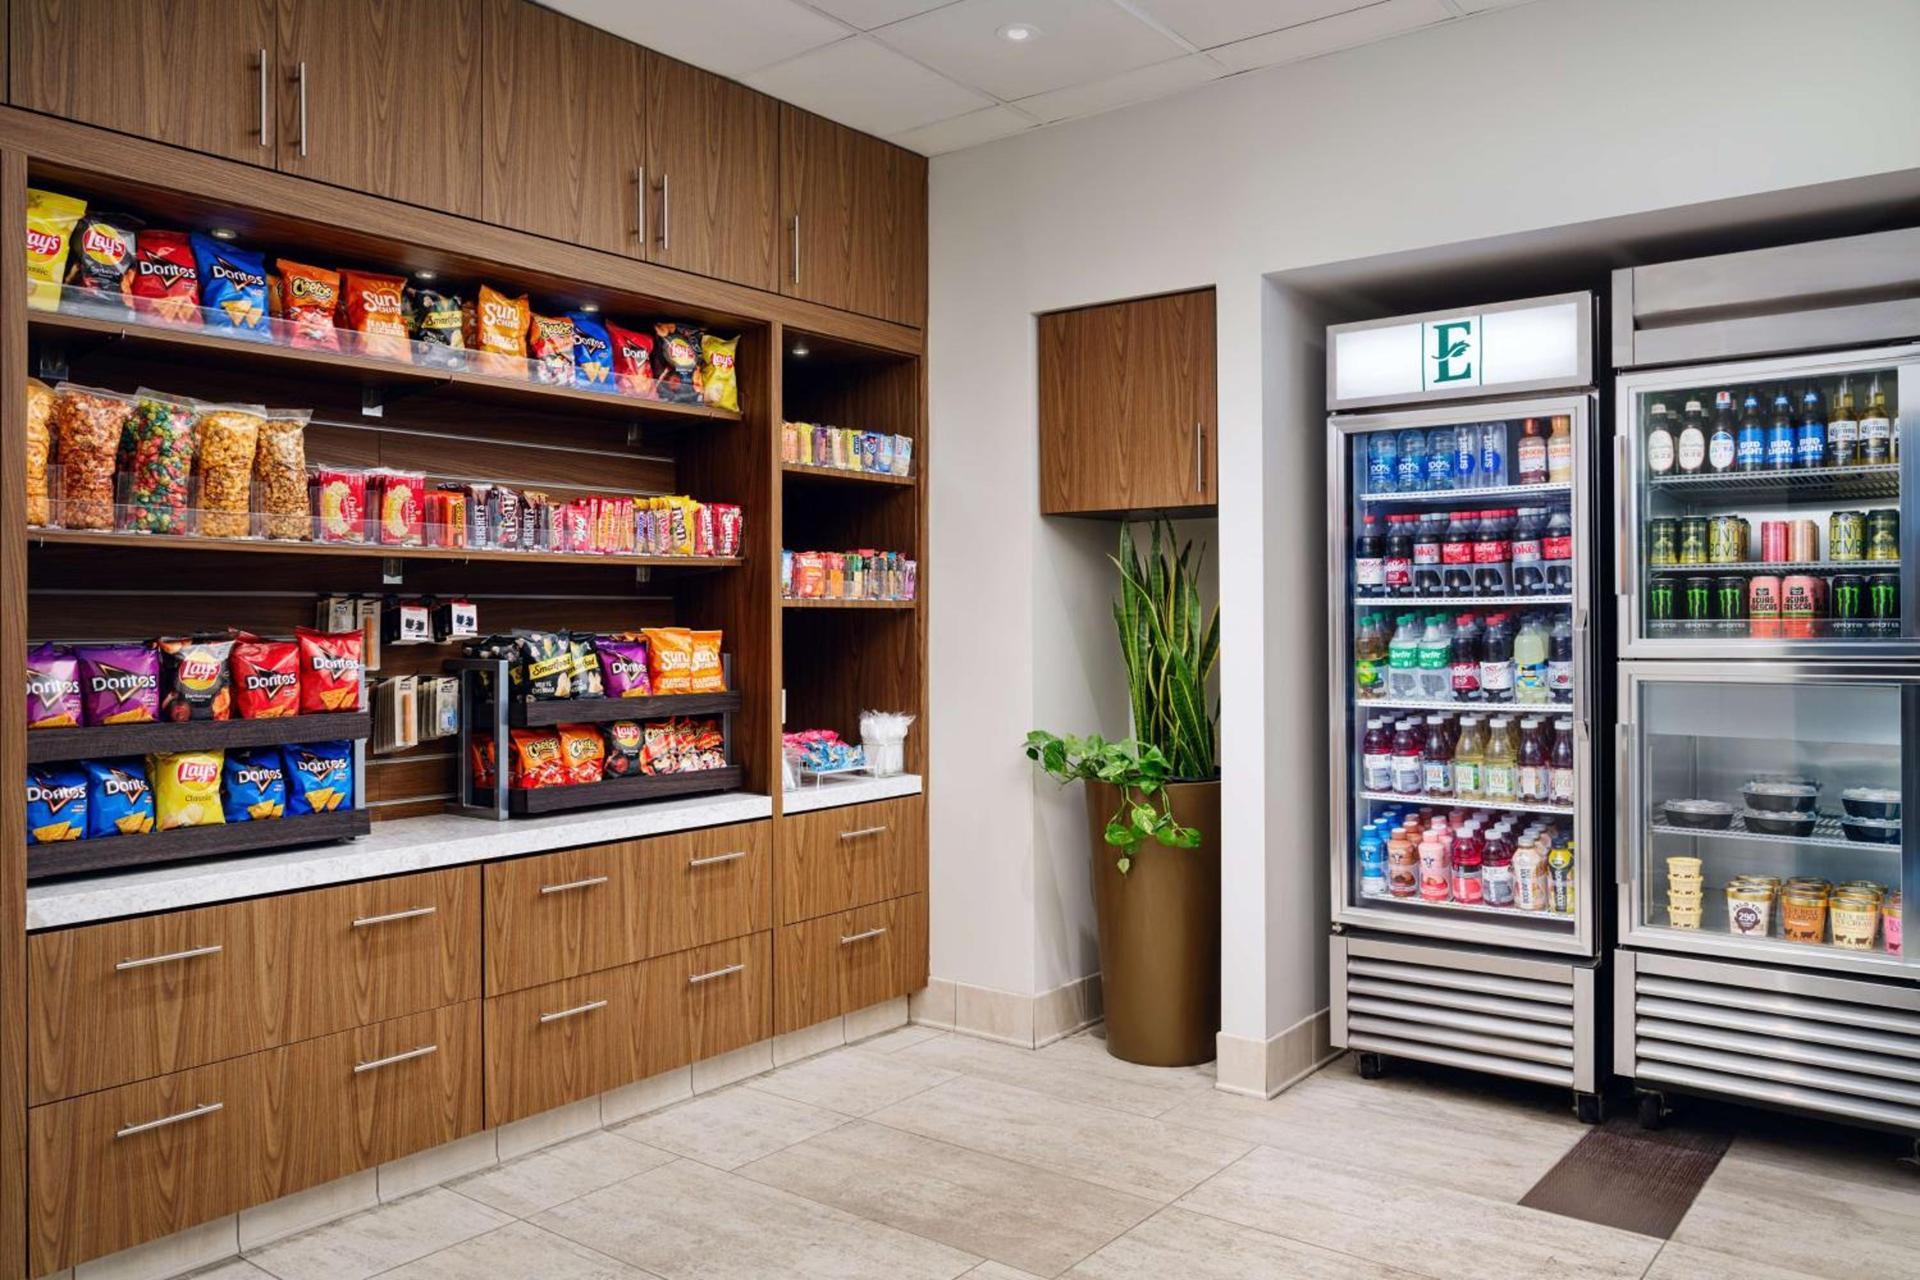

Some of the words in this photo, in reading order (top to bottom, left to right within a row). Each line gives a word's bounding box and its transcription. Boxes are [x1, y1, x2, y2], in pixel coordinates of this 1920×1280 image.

[27, 232, 60, 253] ay's
[140, 261, 196, 279] Doritos
[212, 265, 265, 285] Doritos
[293, 278, 333, 299] Cheetos
[362, 291, 401, 312] Sun
[483, 303, 520, 327] Sun
[574, 335, 606, 349] Doritos
[622, 347, 650, 358] Dorit
[1432, 321, 1472, 383] E
[313, 657, 359, 670] Doritos
[661, 650, 690, 671] Sun
[92, 675, 156, 691] Doritos
[247, 672, 296, 689] Doritos
[180, 762, 216, 782] Lay's
[298, 759, 347, 771] Doritos
[238, 769, 282, 784] Doritos
[27, 786, 86, 801] Doritos
